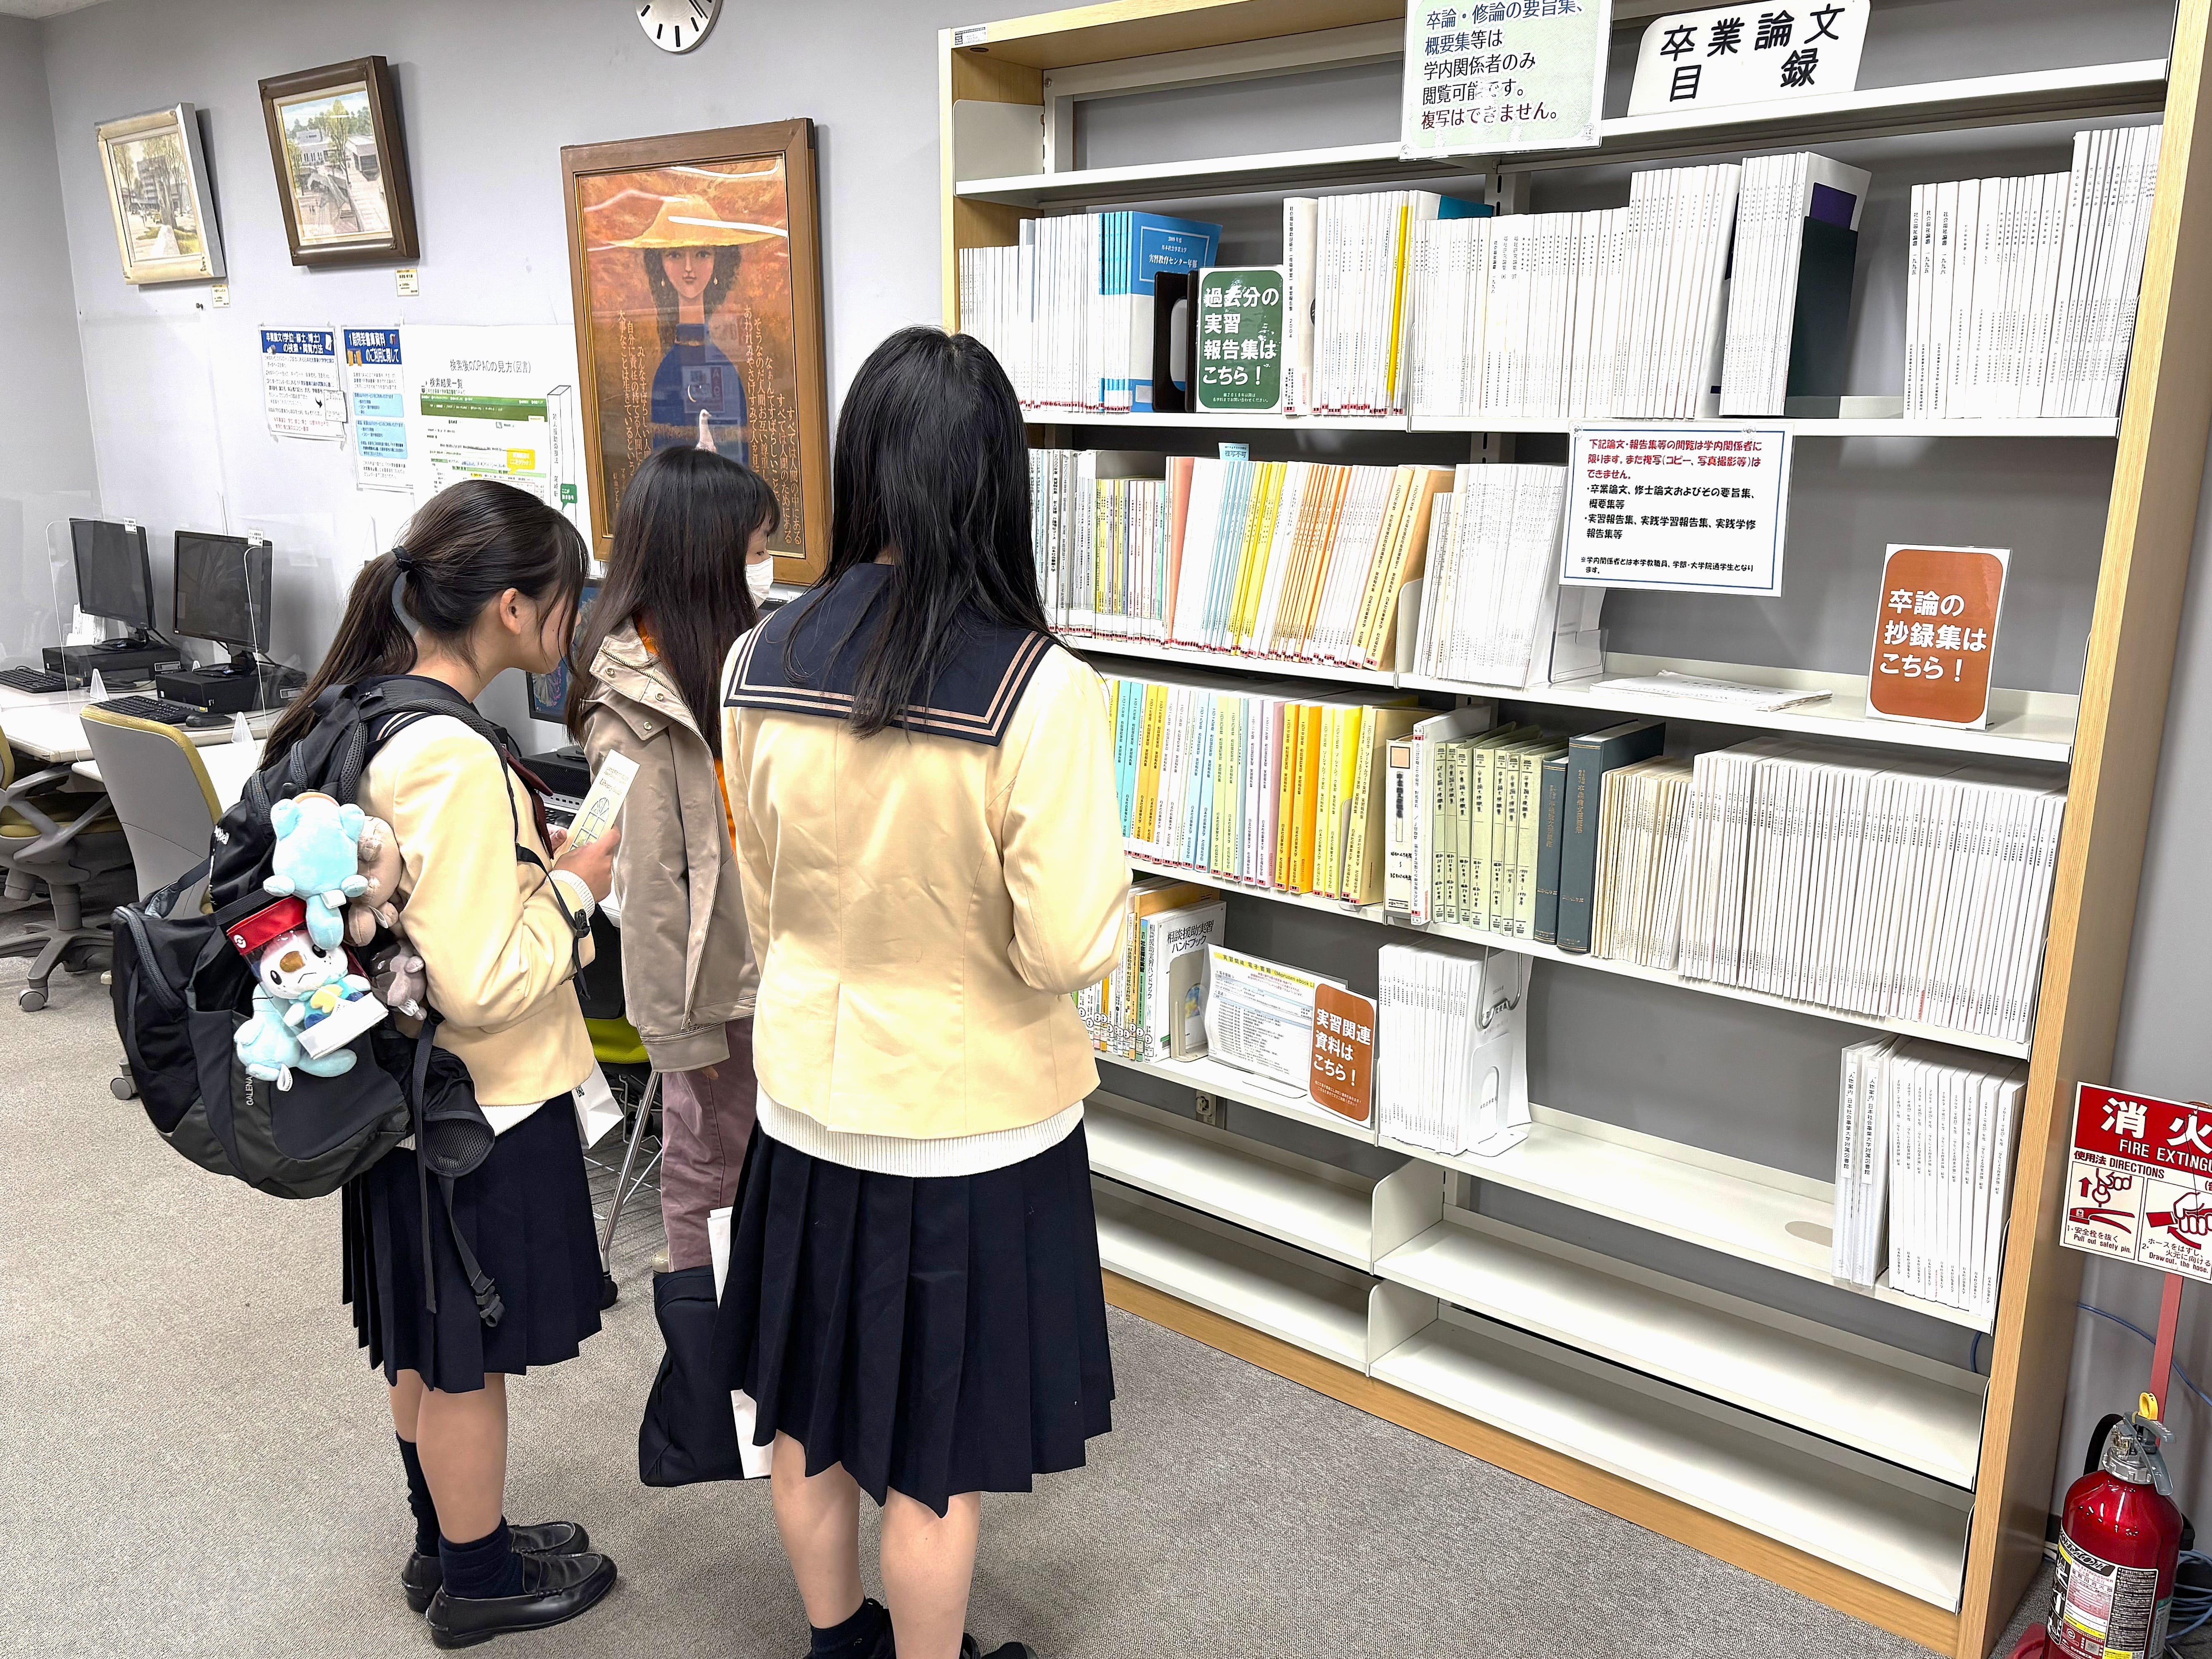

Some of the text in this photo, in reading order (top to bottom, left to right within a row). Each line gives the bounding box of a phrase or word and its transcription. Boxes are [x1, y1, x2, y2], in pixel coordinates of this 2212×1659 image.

[1425, 29, 1503, 56] 概要集等は
[1660, 3, 1845, 62] 卒業論文
[1424, 52, 1536, 81] 学内関係者のみ
[1421, 102, 1557, 130] 複写はできません。
[1203, 286, 1279, 308] 過去分の
[1204, 313, 1241, 334] 実習
[1204, 339, 1277, 360] 報告集は
[1203, 366, 1261, 385] こちら！
[628, 320, 642, 466] 自分に責任の持てる人間に
[1589, 439, 1762, 451] 下記論文・報告集等の閲覧は学内関係者に
[777, 393, 792, 543] すべては人間のためにある
[787, 406, 802, 544] すべては人間の中にある
[1587, 469, 1631, 480] できません。
[1589, 499, 1625, 510] 概要集等
[1587, 529, 1623, 539] 報告集等
[1888, 589, 1965, 617] 卒論の
[1884, 620, 1987, 652] 抄録集は
[1880, 653, 1963, 683] こちら！
[1167, 920, 1214, 944] 相談援助実習
[1172, 935, 1207, 953] ハンドブック
[1316, 1008, 1371, 1046] 実習関連
[1315, 1029, 1354, 1061] 資料は
[1314, 1054, 1356, 1087] こちら！
[245, 1076, 254, 1105] GALENA
[2119, 1139, 2150, 1158] FIRE
[2074, 1151, 2164, 1179] 使用法 DIRECTIONS
[2074, 1234, 2131, 1254] Pull out safety pin.
[2148, 1238, 2202, 1258] ホースをはずし、
[2149, 1251, 2165, 1262] Draw
[2181, 1259, 2190, 1268] the
[2192, 1263, 2209, 1273] hose.
[2165, 1249, 2211, 1266] 火元に向ける
